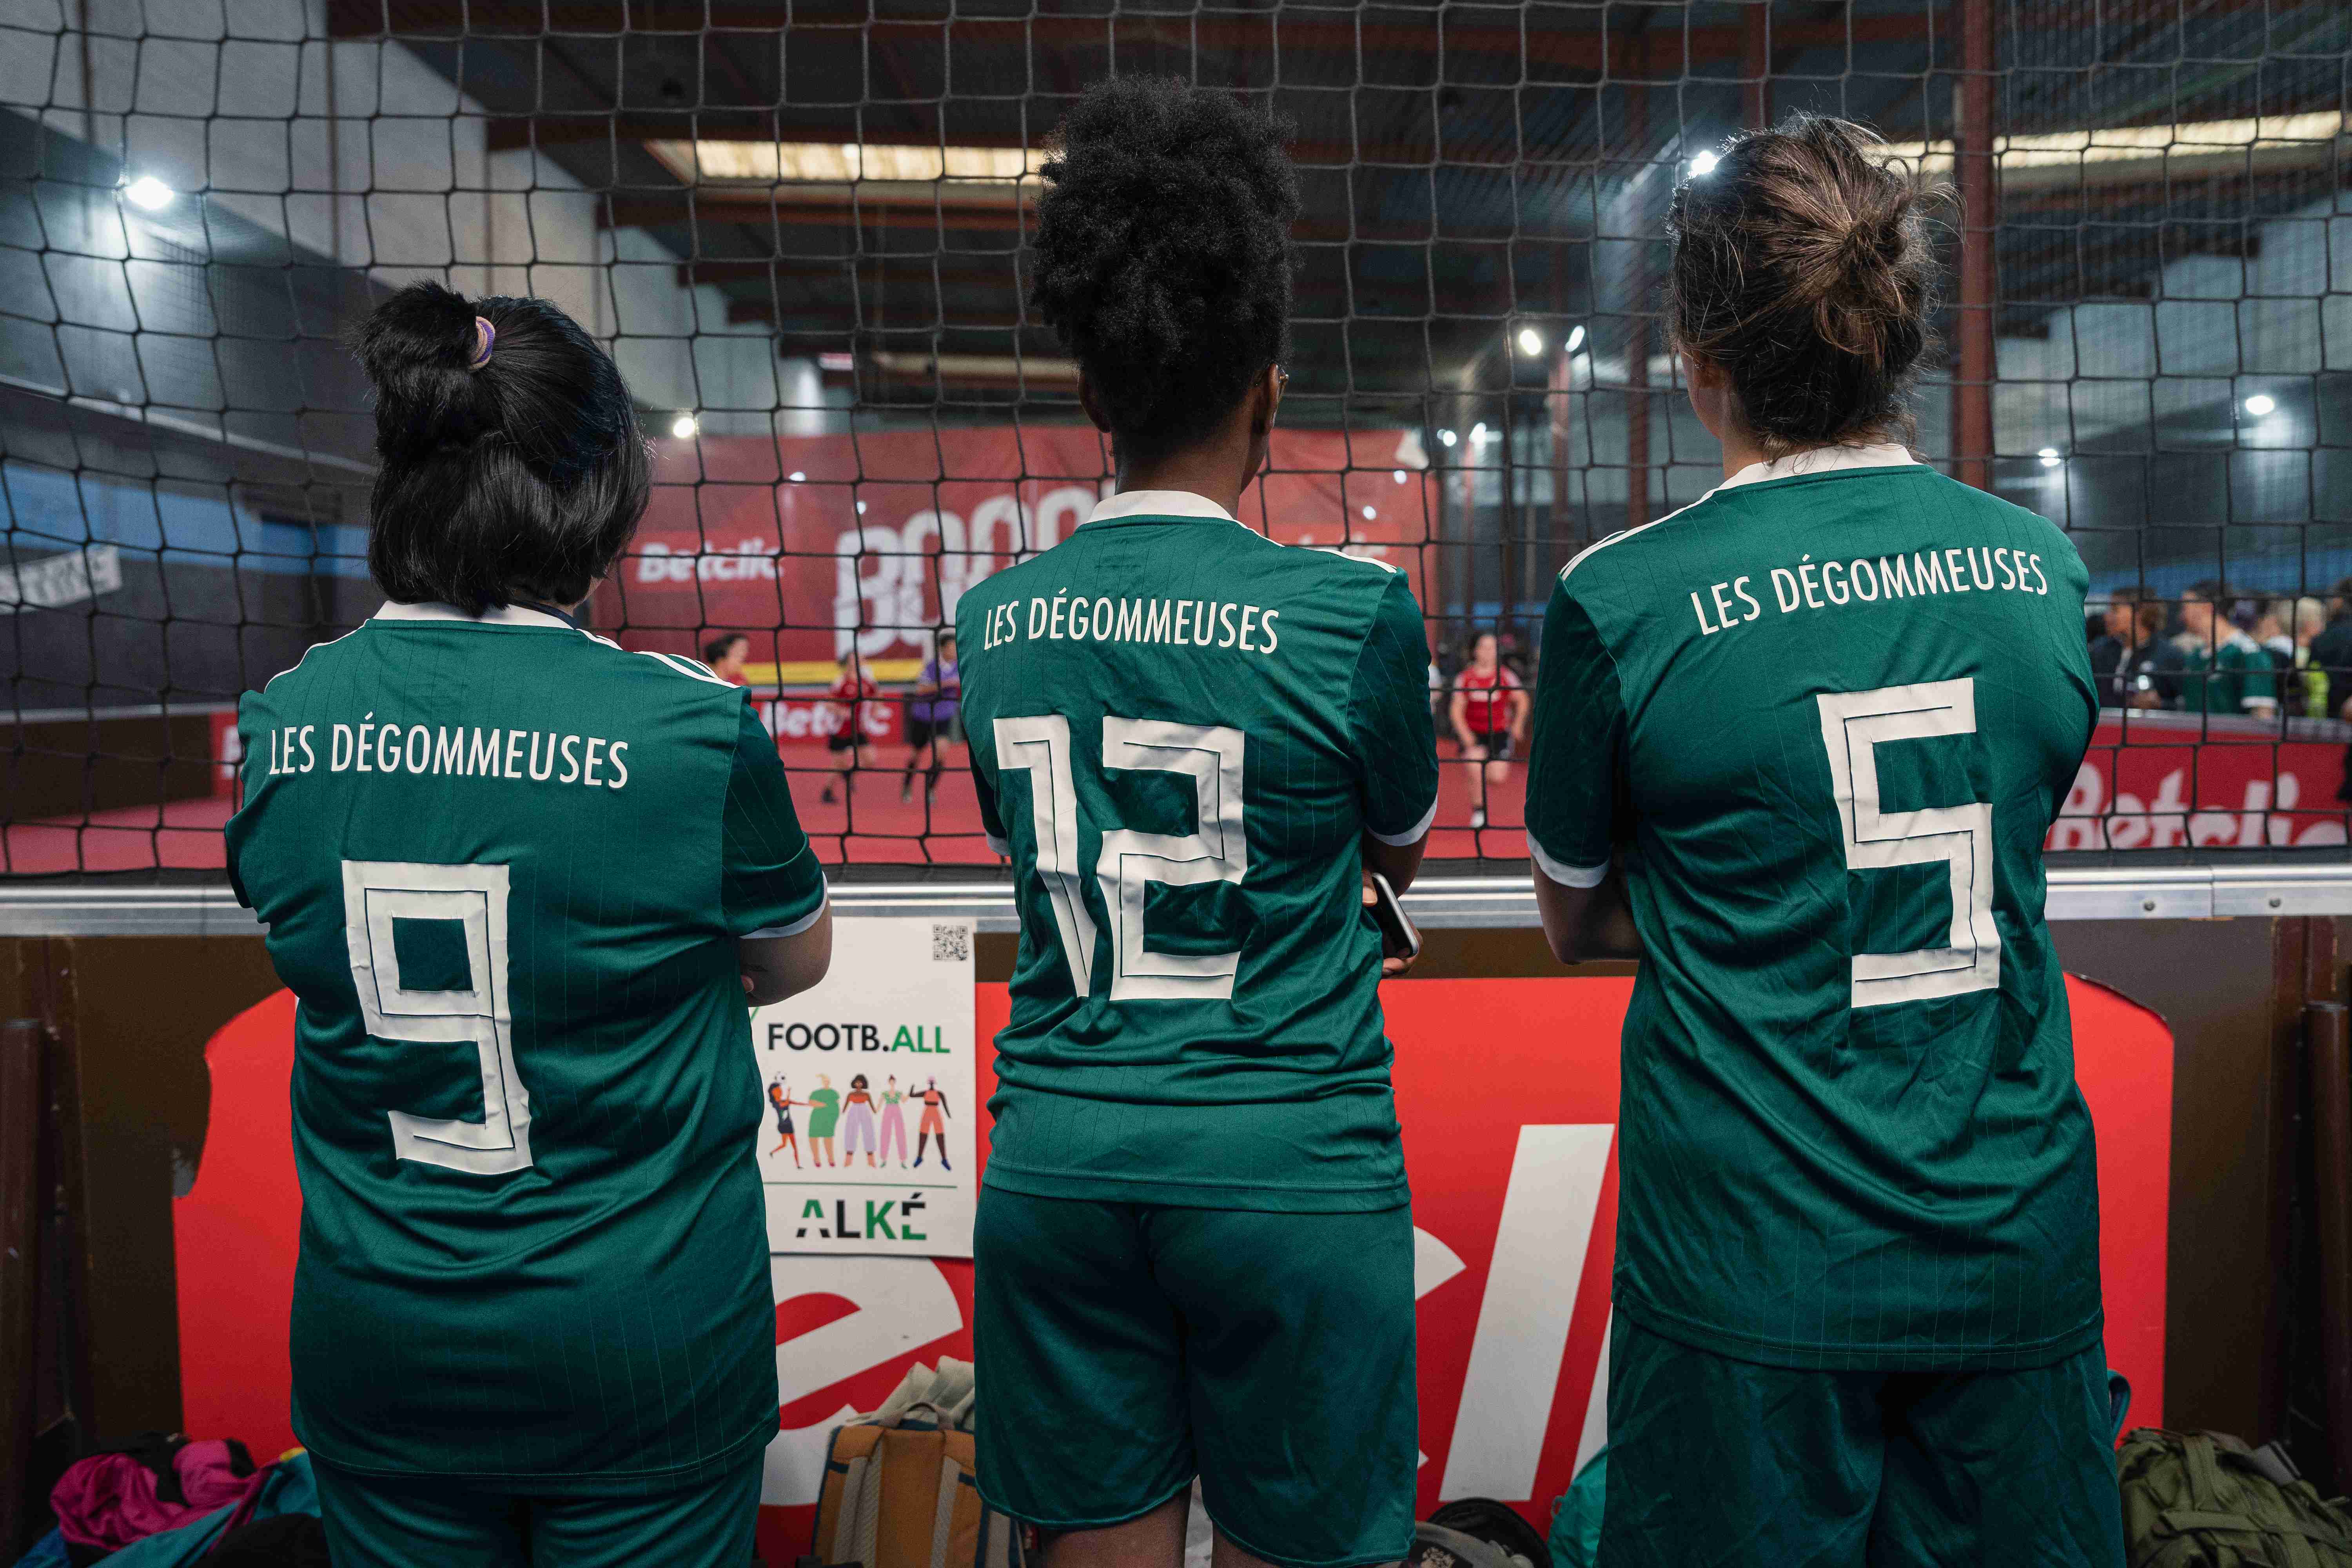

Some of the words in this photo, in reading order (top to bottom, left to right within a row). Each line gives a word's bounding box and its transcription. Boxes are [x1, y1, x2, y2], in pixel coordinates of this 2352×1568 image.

[984, 600, 1020, 650] LES
[1028, 586, 1279, 654] DÉGOMMEUSES
[1690, 575, 1761, 635] LES
[1770, 546, 2048, 613] DÉGOMMEUSES
[269, 724, 315, 775] LES
[330, 711, 628, 789] DÉGOMMEUSES
[993, 715, 1248, 1001] 12
[1816, 677, 2002, 1009] 5
[341, 860, 534, 1175] 9
[768, 1022, 951, 1054] FOOTB.ALL
[796, 1192, 927, 1241] ALKÉ
